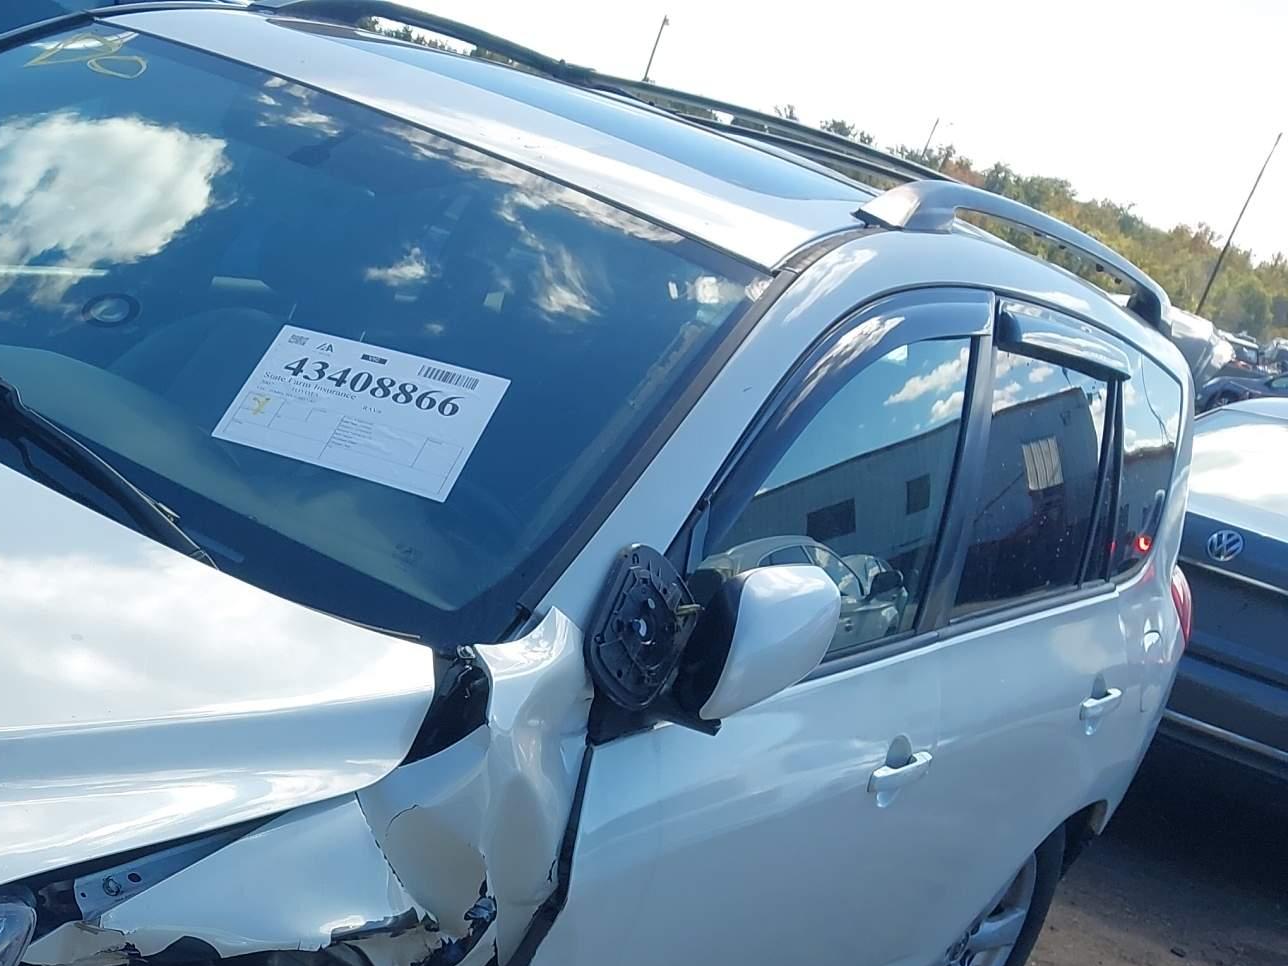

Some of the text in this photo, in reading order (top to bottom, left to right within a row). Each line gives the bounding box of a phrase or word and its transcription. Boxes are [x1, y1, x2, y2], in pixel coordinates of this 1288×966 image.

[263, 370, 287, 382] State
[288, 375, 312, 389] Farm
[313, 383, 358, 401] Insurance
[283, 357, 465, 417] 43408866
